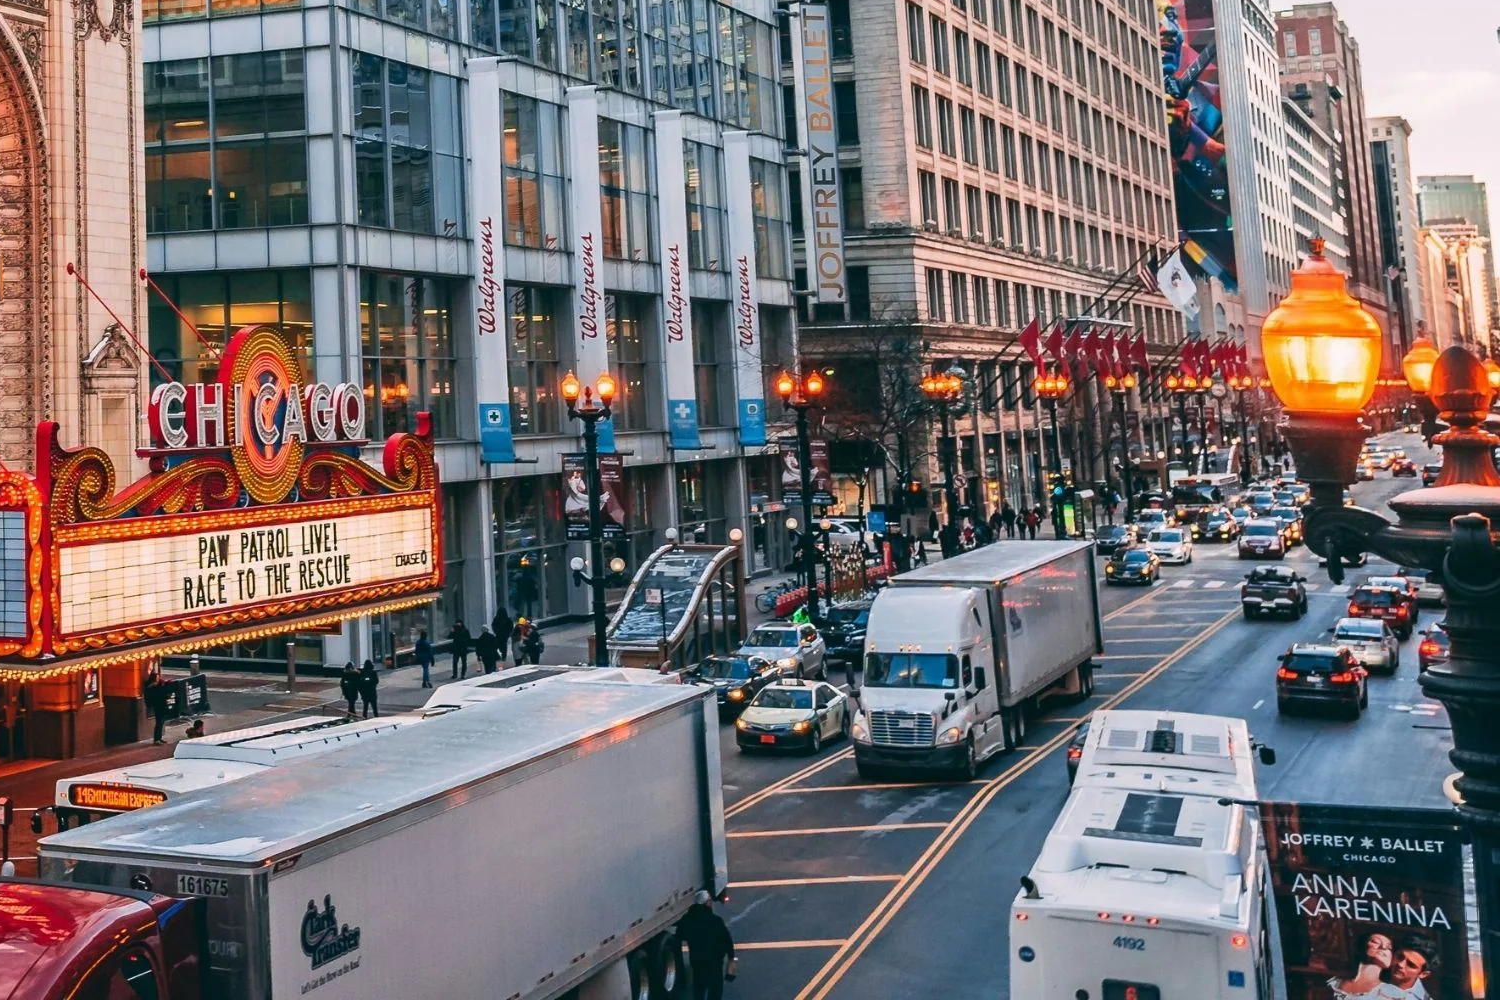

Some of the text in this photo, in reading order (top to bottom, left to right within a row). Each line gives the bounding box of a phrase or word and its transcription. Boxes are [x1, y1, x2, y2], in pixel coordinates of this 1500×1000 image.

[803, 8, 844, 299] JOFFREY BALLET
[479, 217, 501, 336] Walgreens
[580, 232, 604, 341] Walgreens
[665, 244, 689, 344] Walgreens
[737, 256, 756, 349] Walgreens
[155, 381, 365, 449] CHICAGO
[198, 522, 338, 570] PAW PATROL LIVE!
[395, 553, 420, 567] CHASE
[183, 554, 351, 610] RACE TO THE RESCUE
[1281, 833, 1444, 853] JOFFREY BALLET
[1343, 853, 1396, 864] CHICAGO
[179, 876, 229, 897] 161675
[1291, 873, 1383, 899] ANNA
[1294, 895, 1451, 930] KARENINA
[1112, 936, 1146, 951] 4192
